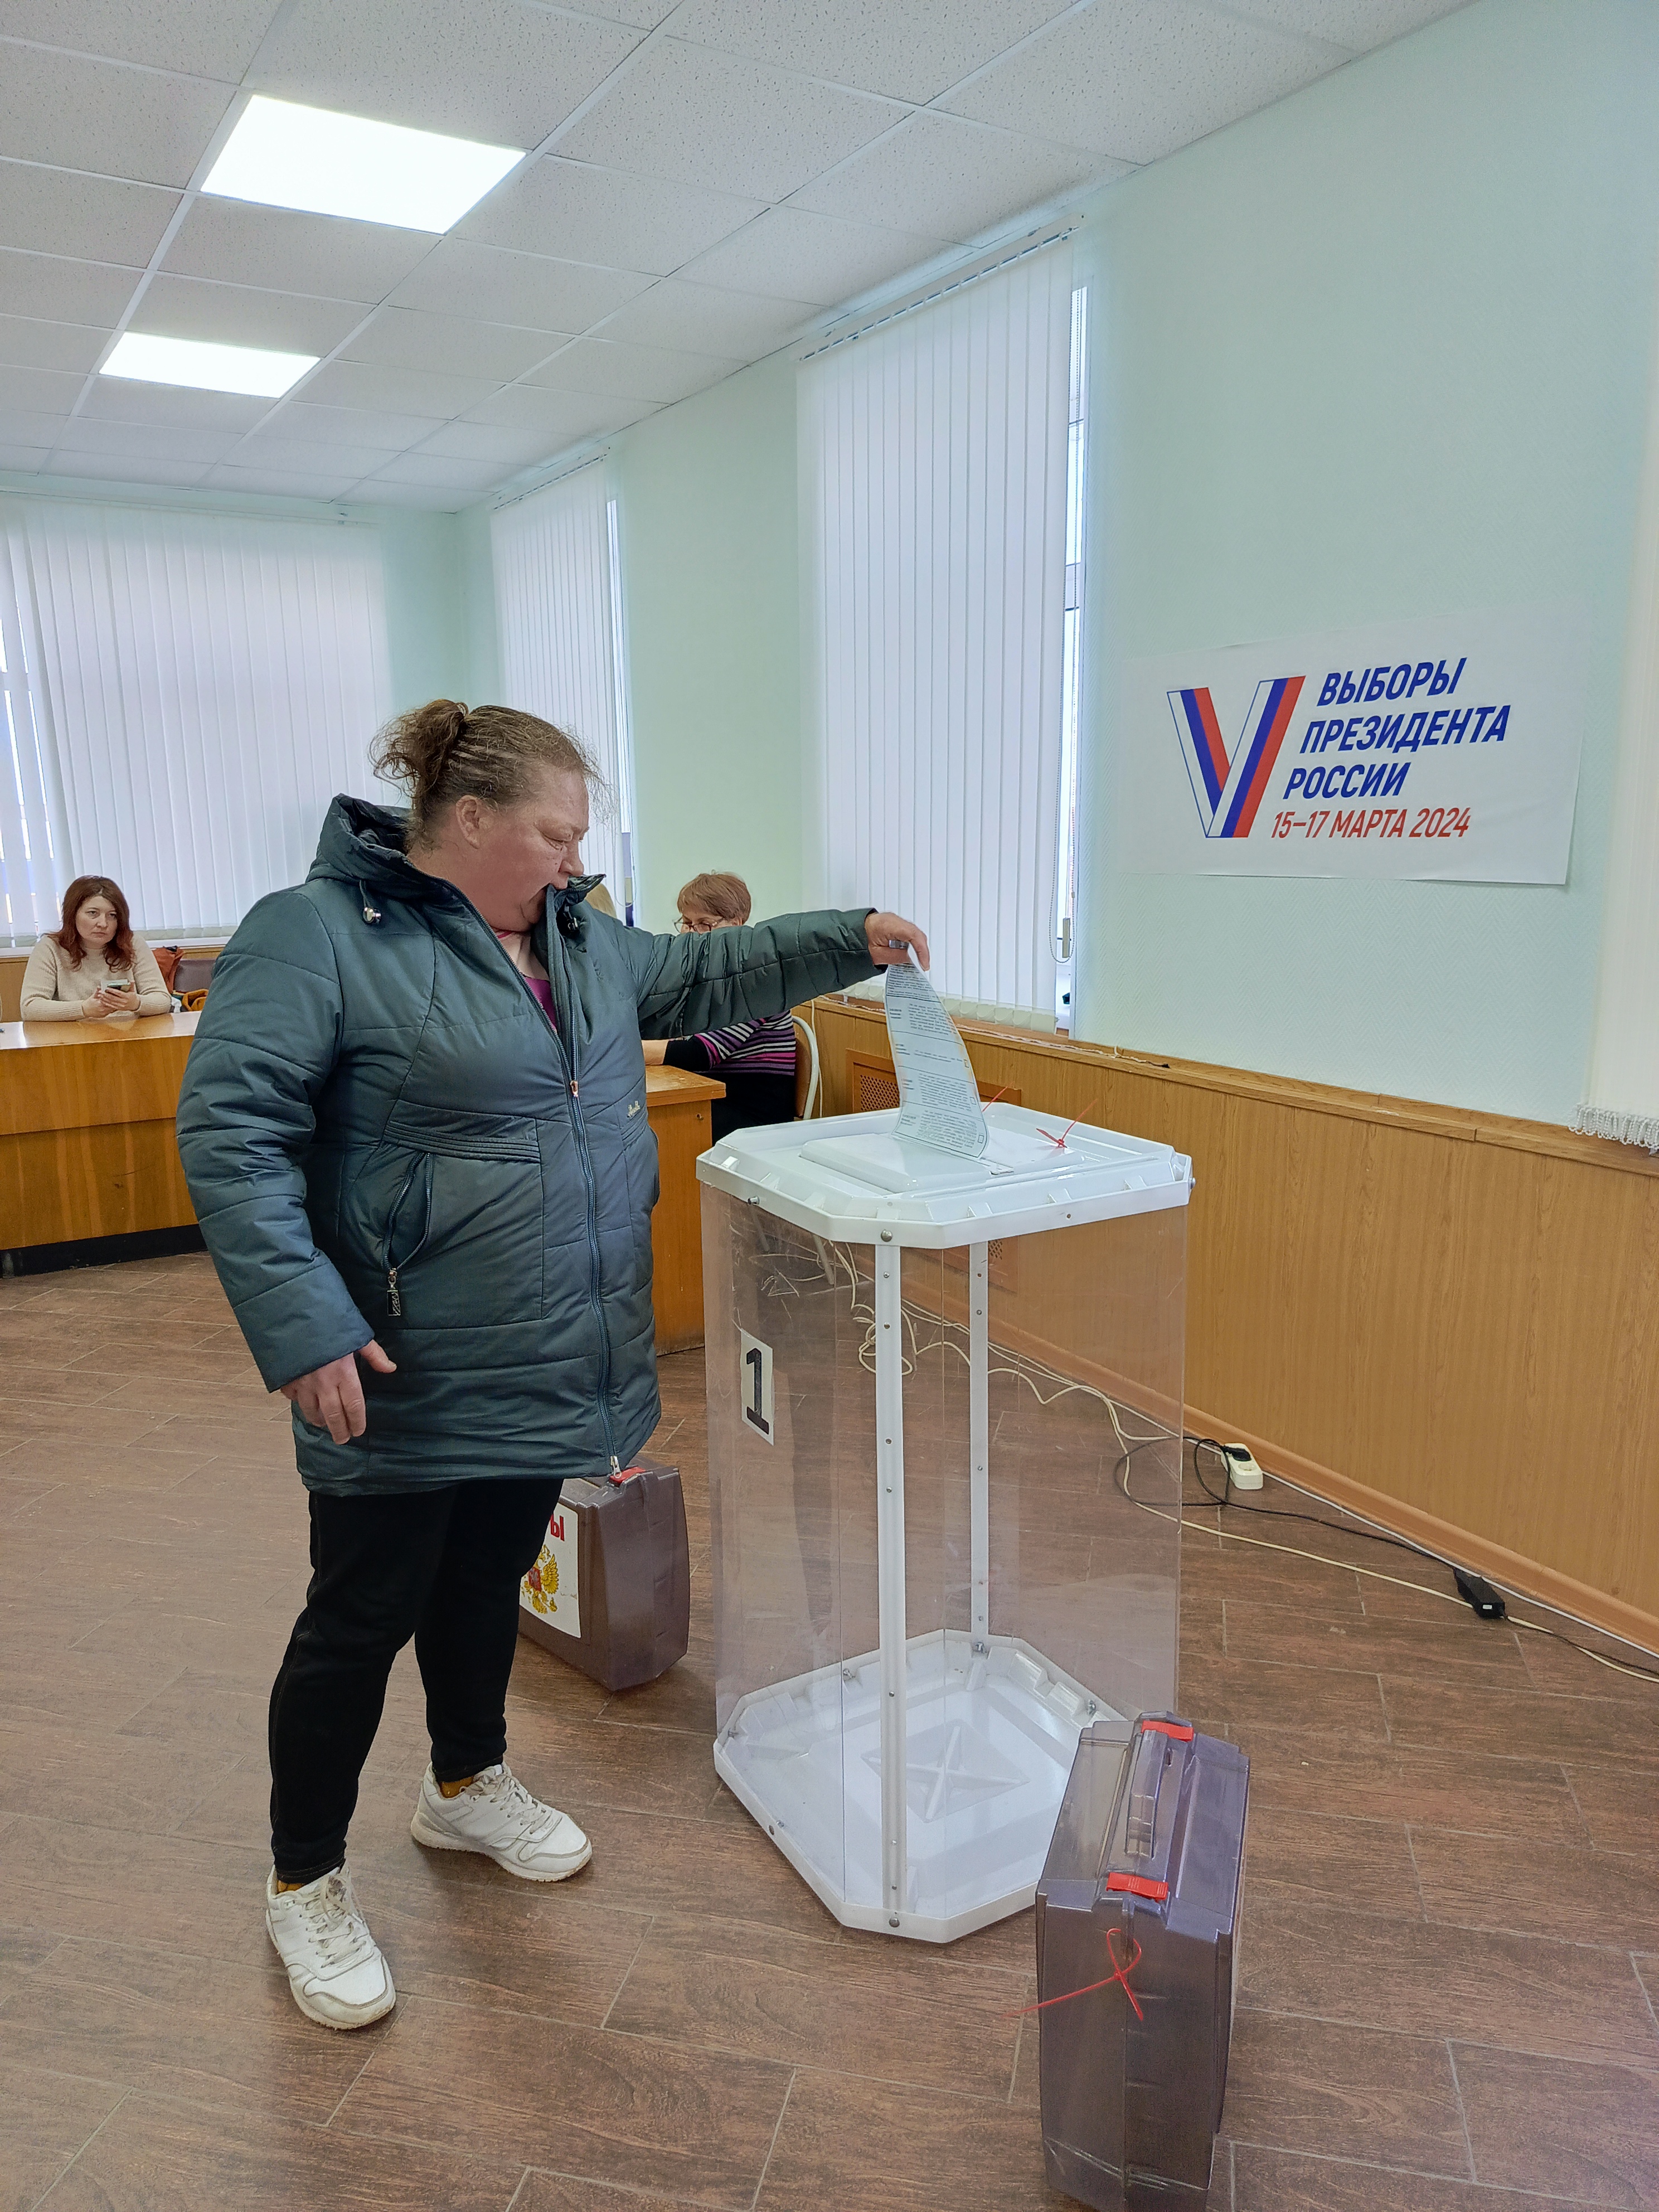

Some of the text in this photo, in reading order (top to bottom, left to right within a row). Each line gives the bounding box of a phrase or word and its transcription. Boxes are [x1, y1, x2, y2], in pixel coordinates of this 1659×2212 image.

[1317, 657, 1467, 706] ВЫБОРЫ
[1299, 705, 1511, 754] ПРЕЗИДЕНТА
[1283, 762, 1411, 799] РОССИИ
[1328, 809, 1407, 838] МАРТА
[1408, 807, 1471, 838] 2024
[746, 1347, 769, 1435] 1
